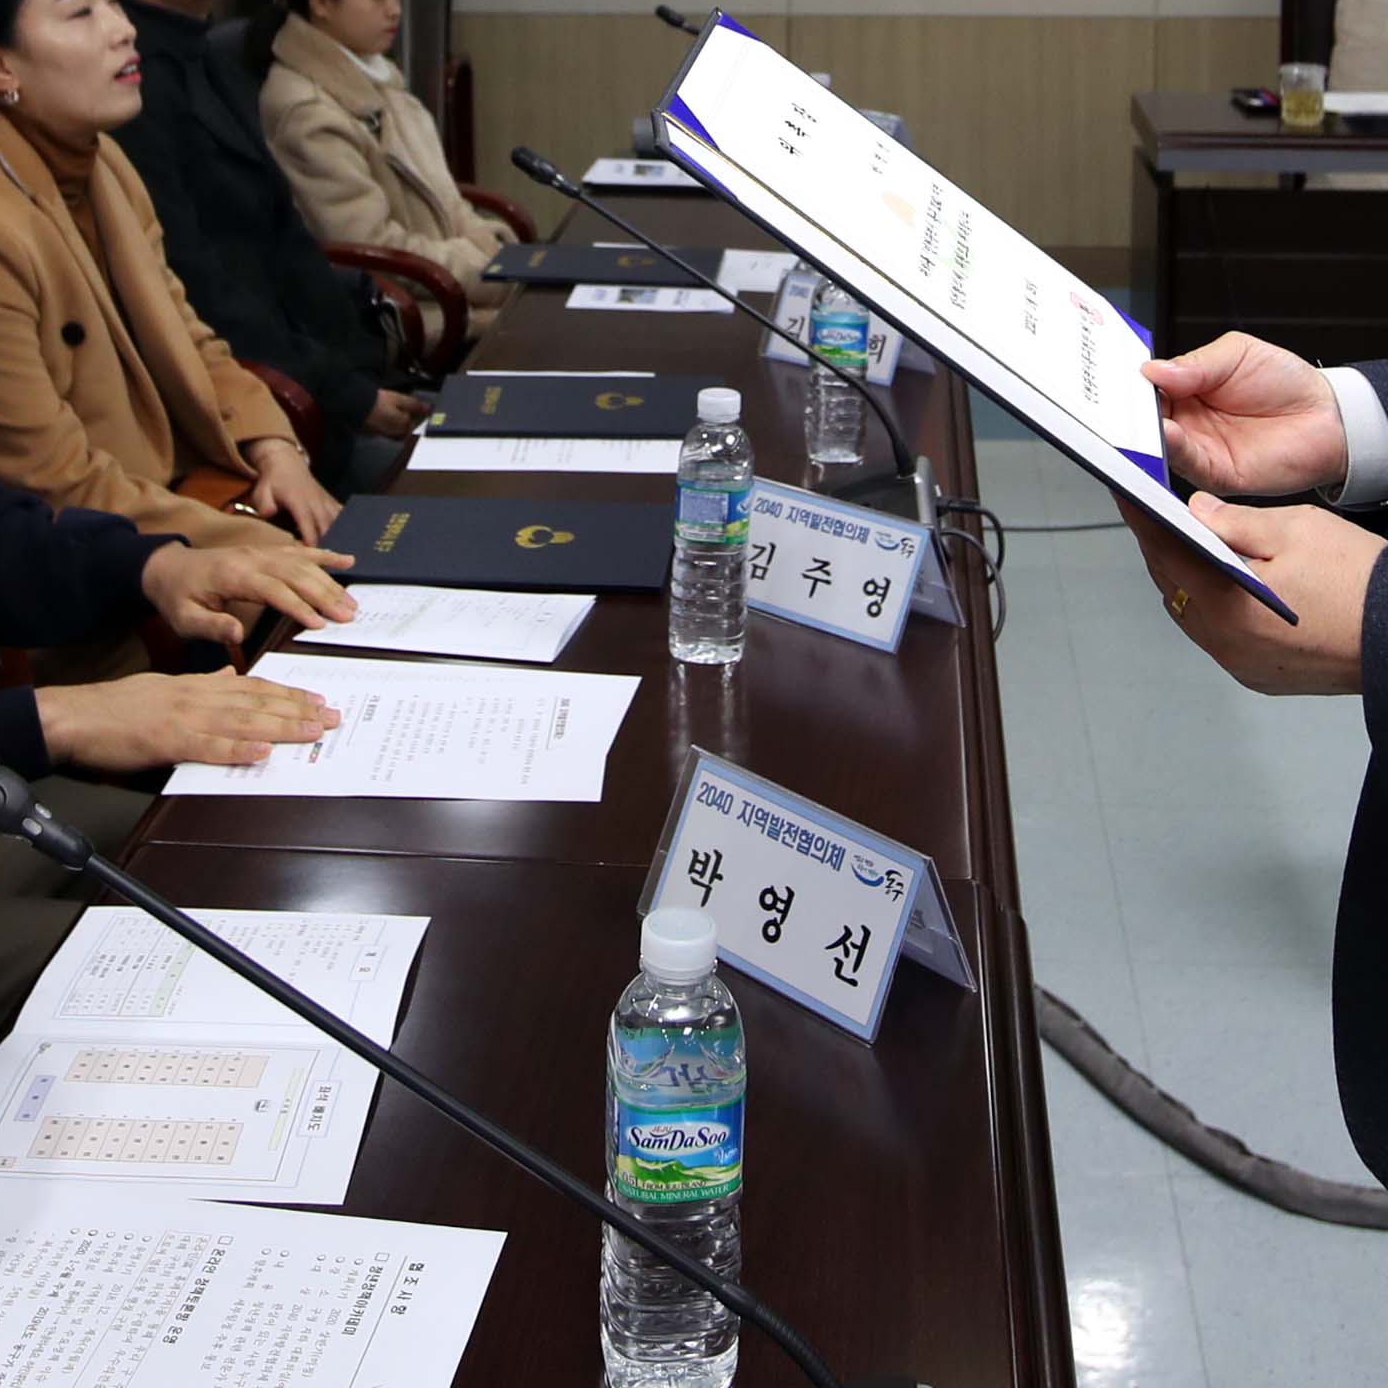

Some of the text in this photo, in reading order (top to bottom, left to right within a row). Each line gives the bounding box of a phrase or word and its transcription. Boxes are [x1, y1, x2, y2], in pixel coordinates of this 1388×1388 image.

[753, 496, 783, 519] 2040
[786, 506, 871, 545] 지역발전협의체
[696, 781, 734, 816] 2040
[736, 800, 847, 872] 지역발전협의체
[629, 1126, 727, 1151] SamDaSoo
[660, 1188, 699, 1200] MINERAL
[700, 1183, 729, 1196] WATER
